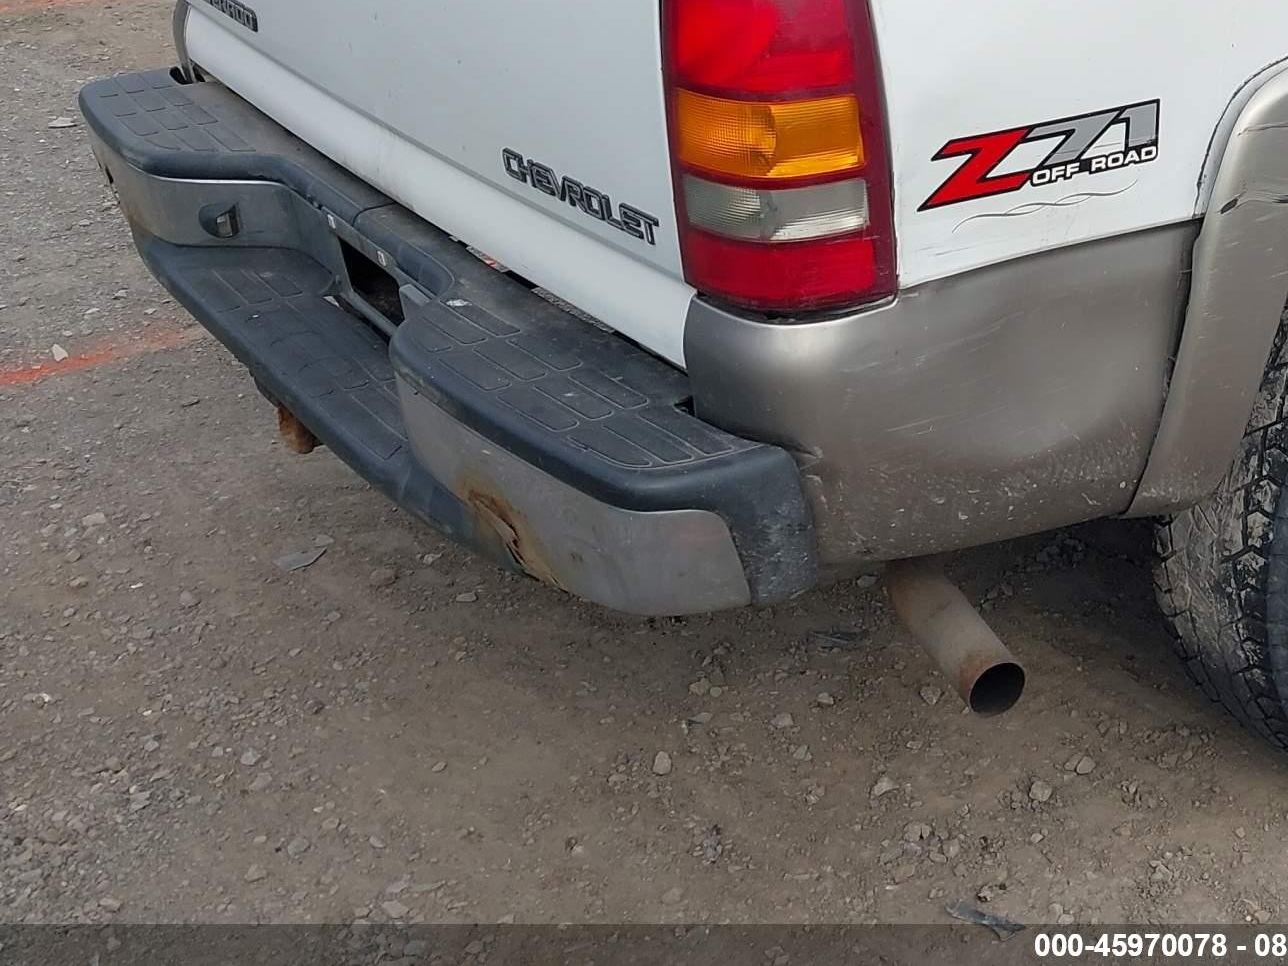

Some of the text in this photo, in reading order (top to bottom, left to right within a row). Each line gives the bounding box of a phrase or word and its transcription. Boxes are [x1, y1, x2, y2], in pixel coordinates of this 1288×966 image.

[502, 147, 660, 246] CHEVROLET
[917, 98, 1160, 212] Z71
[1031, 145, 1157, 186] OFF ROAD
